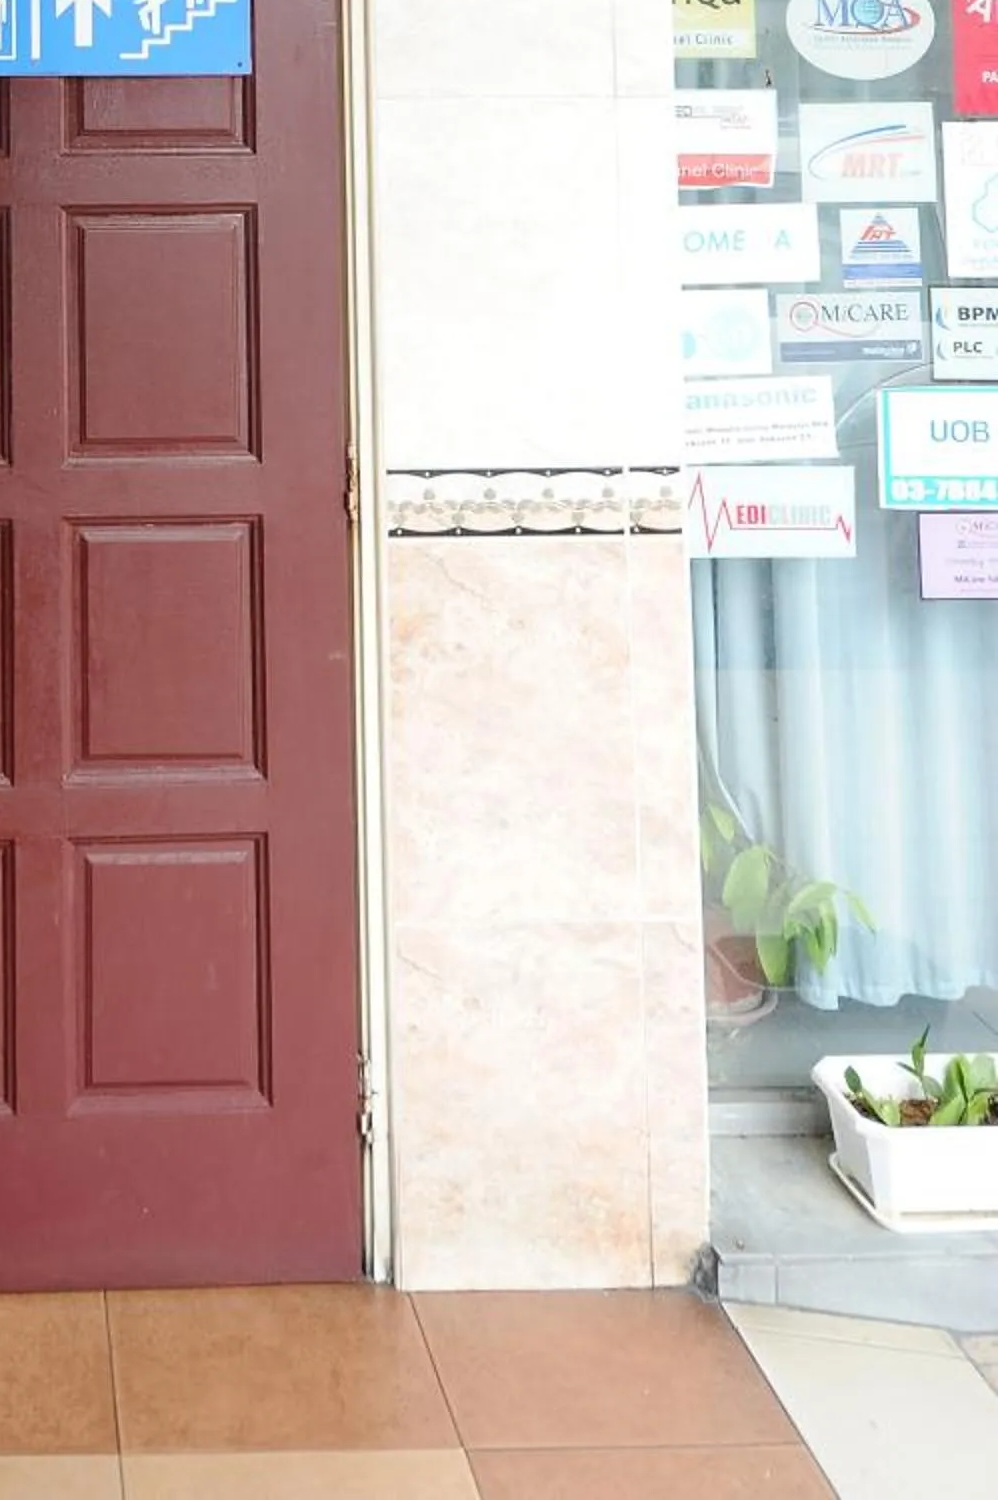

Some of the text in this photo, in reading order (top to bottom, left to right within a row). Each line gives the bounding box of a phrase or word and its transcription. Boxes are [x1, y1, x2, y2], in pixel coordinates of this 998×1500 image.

[842, 153, 903, 179] MRT
[953, 341, 983, 353] PLC
[930, 419, 990, 443] UOB
